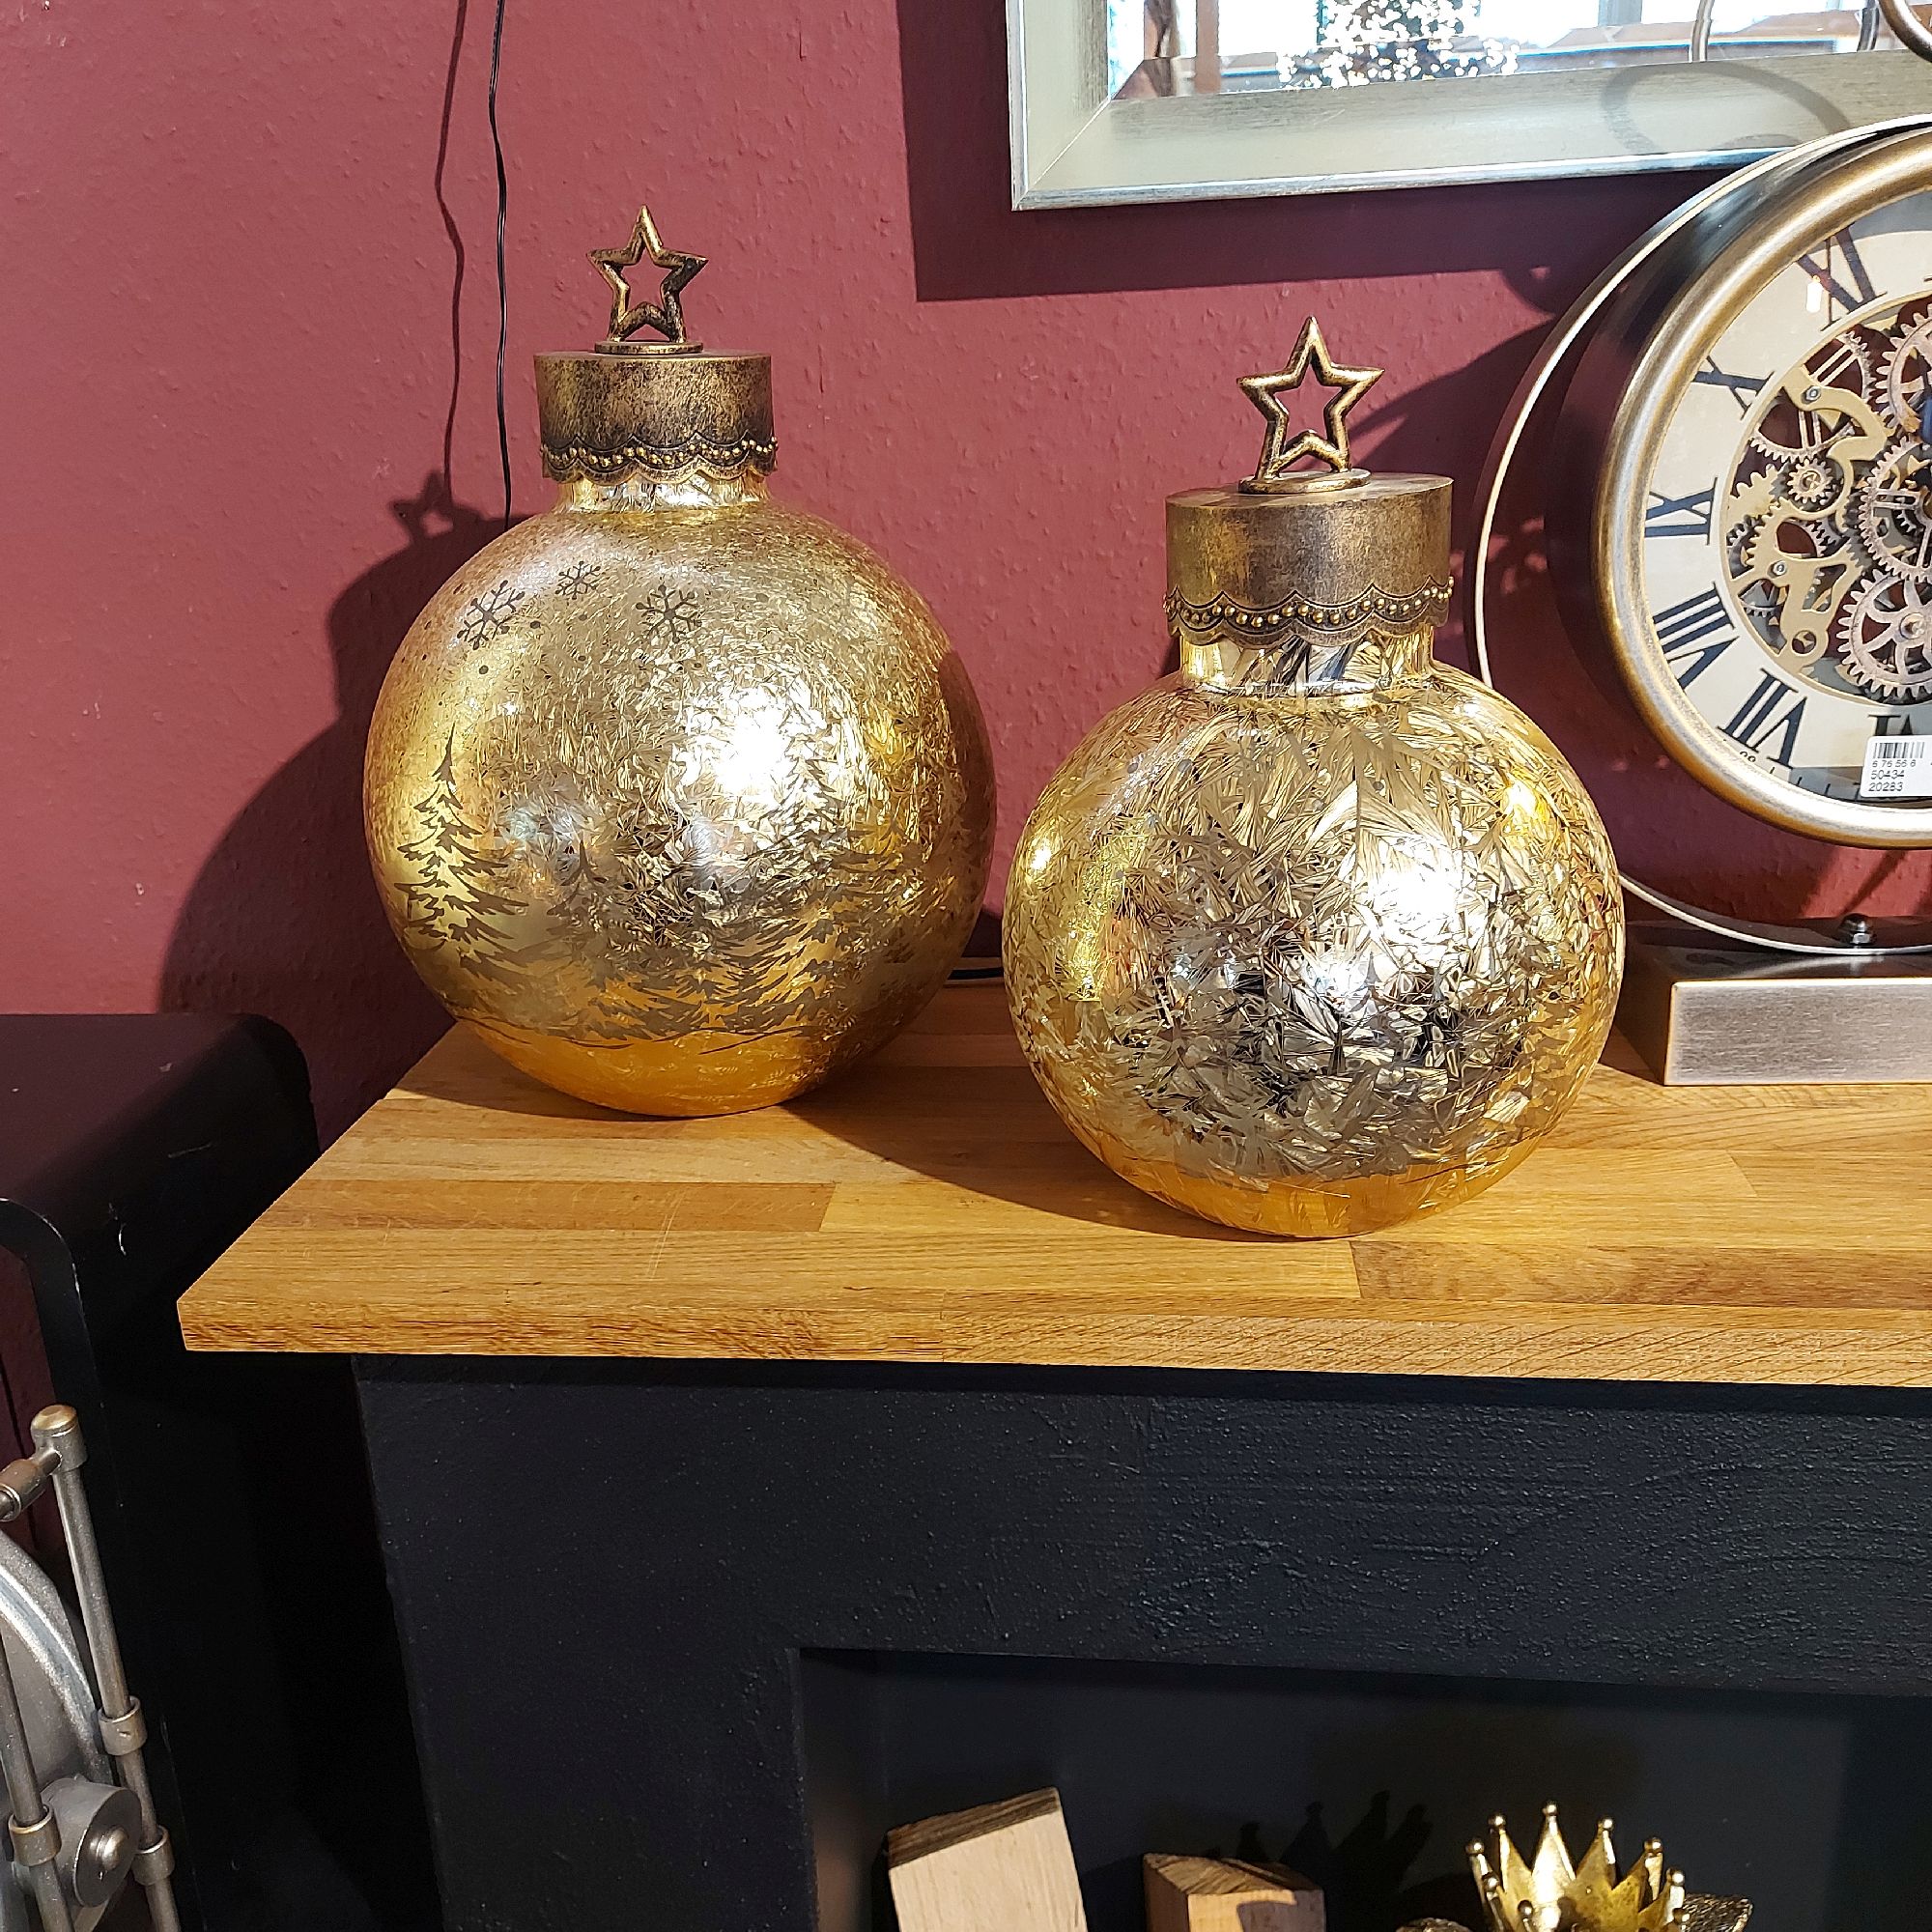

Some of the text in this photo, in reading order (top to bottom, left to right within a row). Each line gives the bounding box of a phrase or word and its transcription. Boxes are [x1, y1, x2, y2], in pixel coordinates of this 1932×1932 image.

[1691, 355, 1775, 422] X
[1653, 582, 1739, 691] VIII
[1718, 668, 1807, 769] VII
